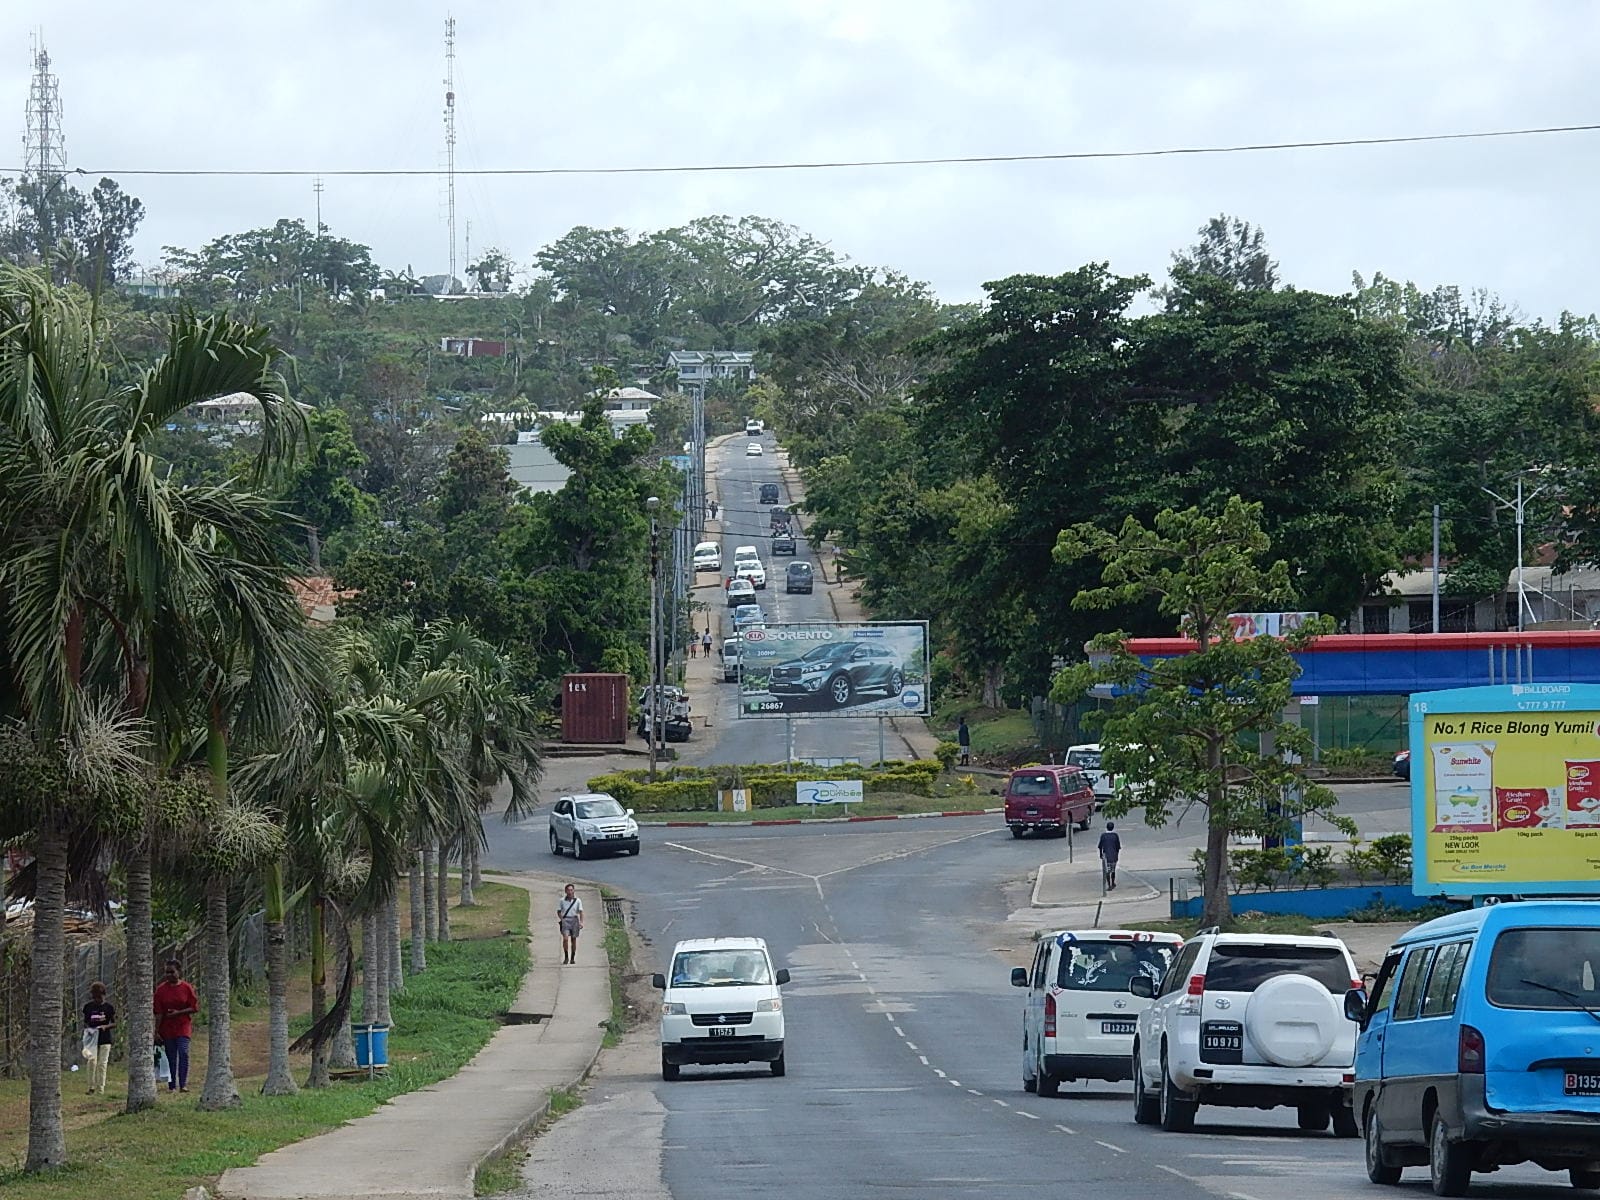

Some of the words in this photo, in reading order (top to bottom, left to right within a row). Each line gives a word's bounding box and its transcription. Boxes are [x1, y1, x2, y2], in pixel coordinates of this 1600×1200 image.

[767, 631, 833, 640] SORENTO
[760, 702, 784, 710] 26867
[1414, 703, 1428, 713] 18
[1525, 701, 1540, 710] 777
[1543, 701, 1549, 709] 9
[1551, 700, 1566, 709] 777
[1434, 721, 1466, 734] No.1
[1471, 721, 1503, 734] Rice
[1507, 721, 1550, 737] Blong
[1554, 721, 1595, 734] Yumi!
[1207, 1036, 1239, 1048] 10979
